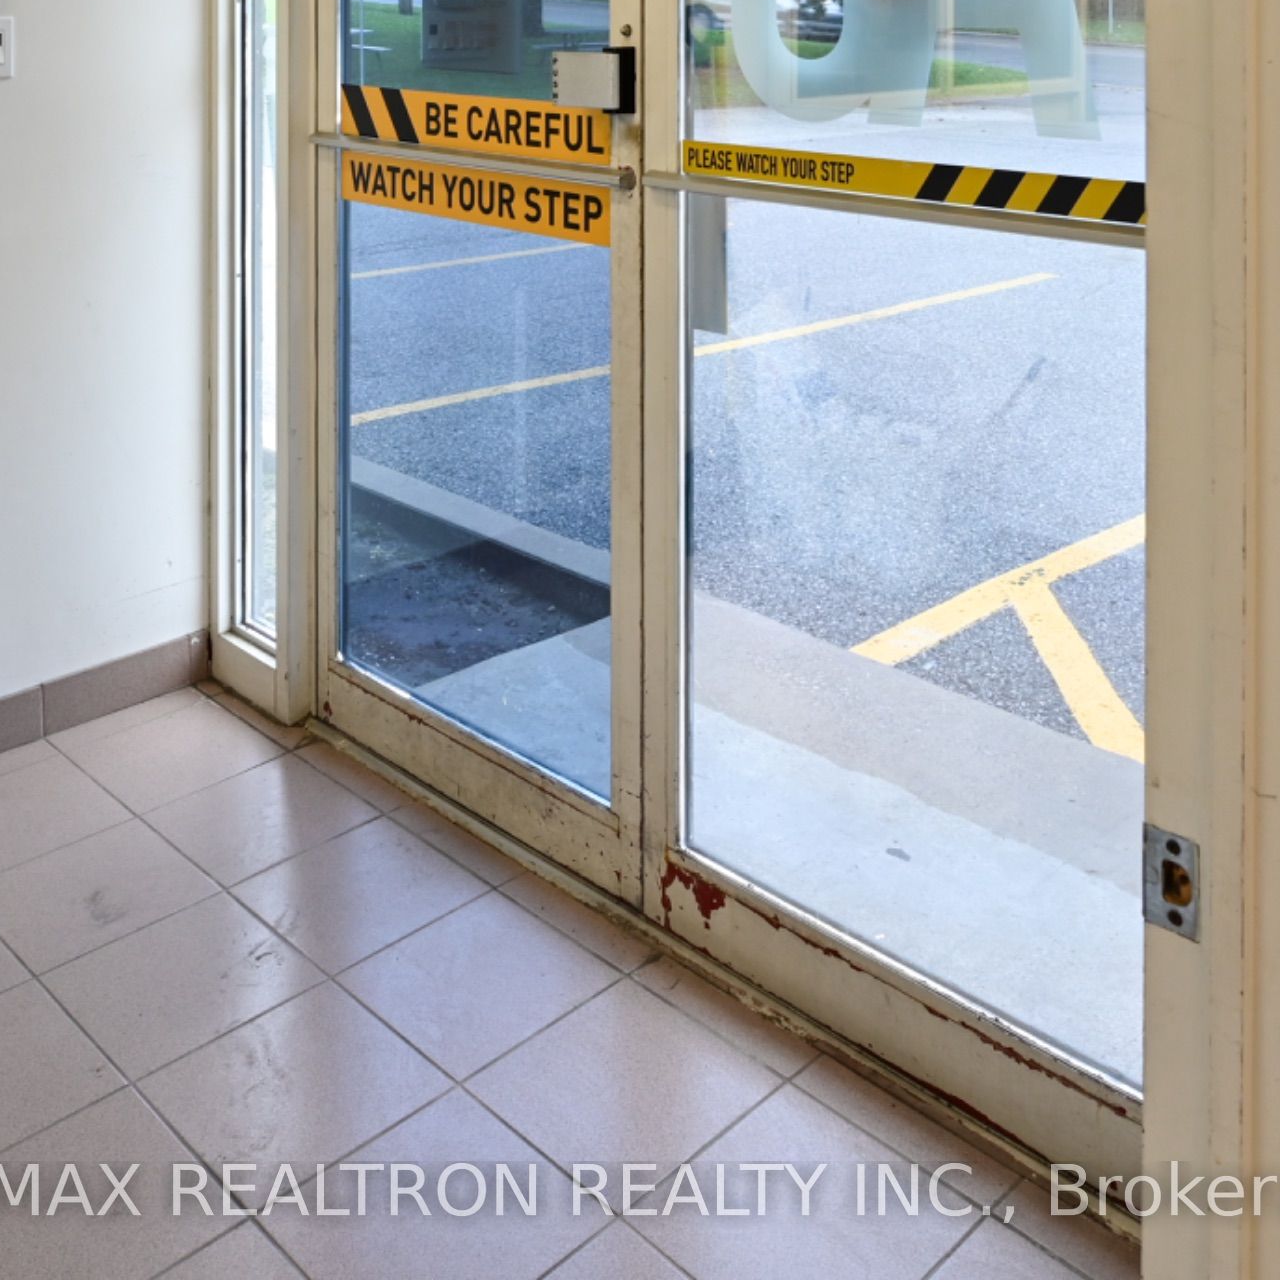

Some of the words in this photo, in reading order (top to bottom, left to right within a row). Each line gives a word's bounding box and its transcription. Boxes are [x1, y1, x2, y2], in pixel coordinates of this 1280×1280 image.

[425, 101, 459, 138] BE
[466, 105, 605, 155] CAREFUL
[687, 147, 732, 171] PLEASE
[735, 151, 778, 176] WATCH
[781, 156, 818, 181] YOUR
[820, 160, 856, 185] STEP
[350, 159, 434, 206] WATCH
[441, 173, 516, 220] YOUR
[523, 186, 604, 233] STEP
